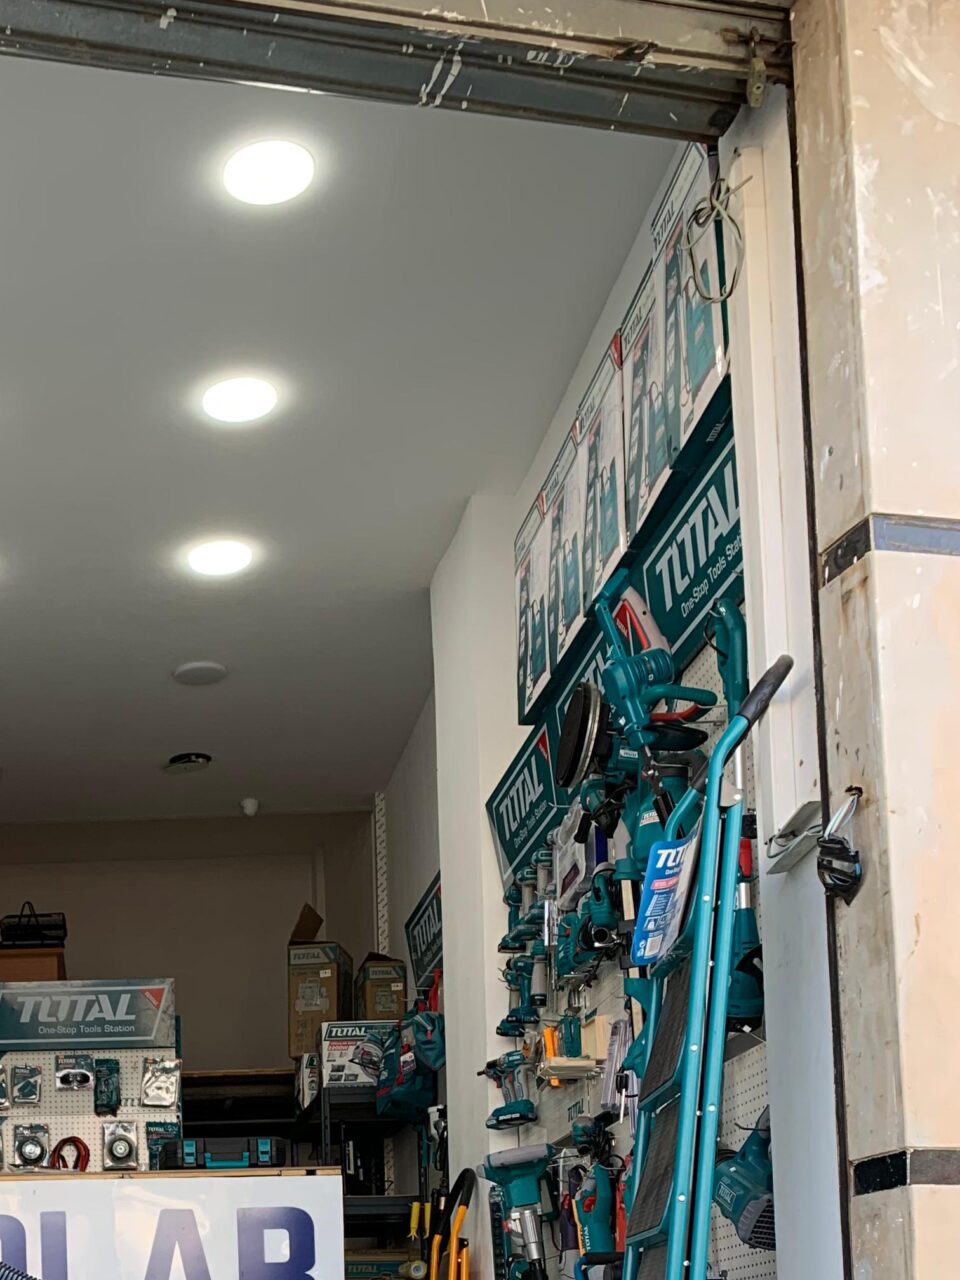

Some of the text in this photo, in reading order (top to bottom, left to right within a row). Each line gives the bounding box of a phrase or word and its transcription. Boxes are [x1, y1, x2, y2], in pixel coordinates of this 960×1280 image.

[655, 460, 741, 613] TOTAL
[680, 578, 709, 618] One-Stop
[707, 555, 727, 583] Tools
[499, 754, 544, 841] TOTAL
[413, 898, 442, 958] TOTAL
[293, 952, 322, 961] TOTAL
[17, 993, 137, 1024] TOTAL
[38, 1024, 136, 1036] One-Stop Tools Station
[330, 1026, 368, 1037] TOTAL
[567, 1097, 585, 1123] TOTAL
[719, 1184, 733, 1204] TOTAL
[583, 1224, 592, 1251] TOTAL
[348, 1264, 378, 1273] TOTAL
